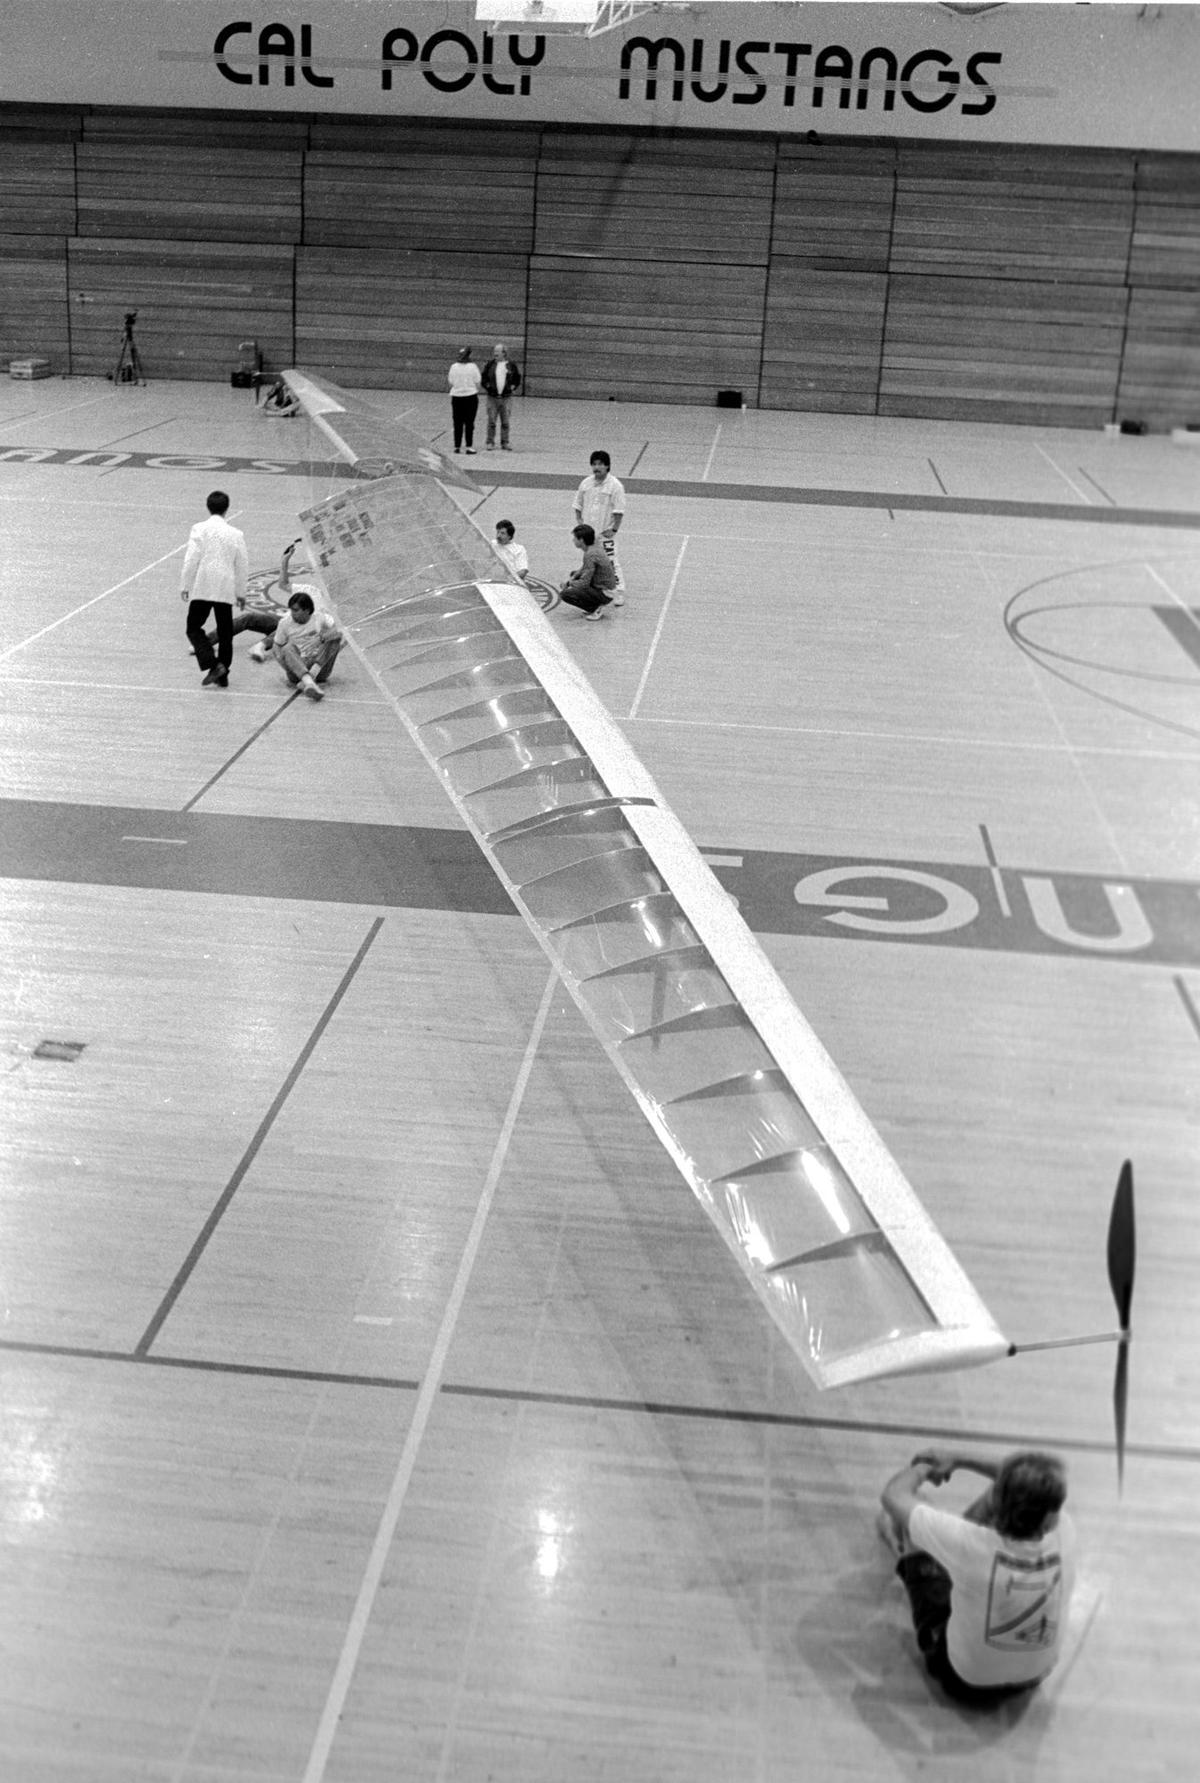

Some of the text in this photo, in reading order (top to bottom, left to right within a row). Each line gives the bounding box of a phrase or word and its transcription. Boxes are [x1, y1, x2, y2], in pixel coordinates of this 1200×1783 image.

[213, 21, 1003, 116] CAL POLY MUSTANGS
